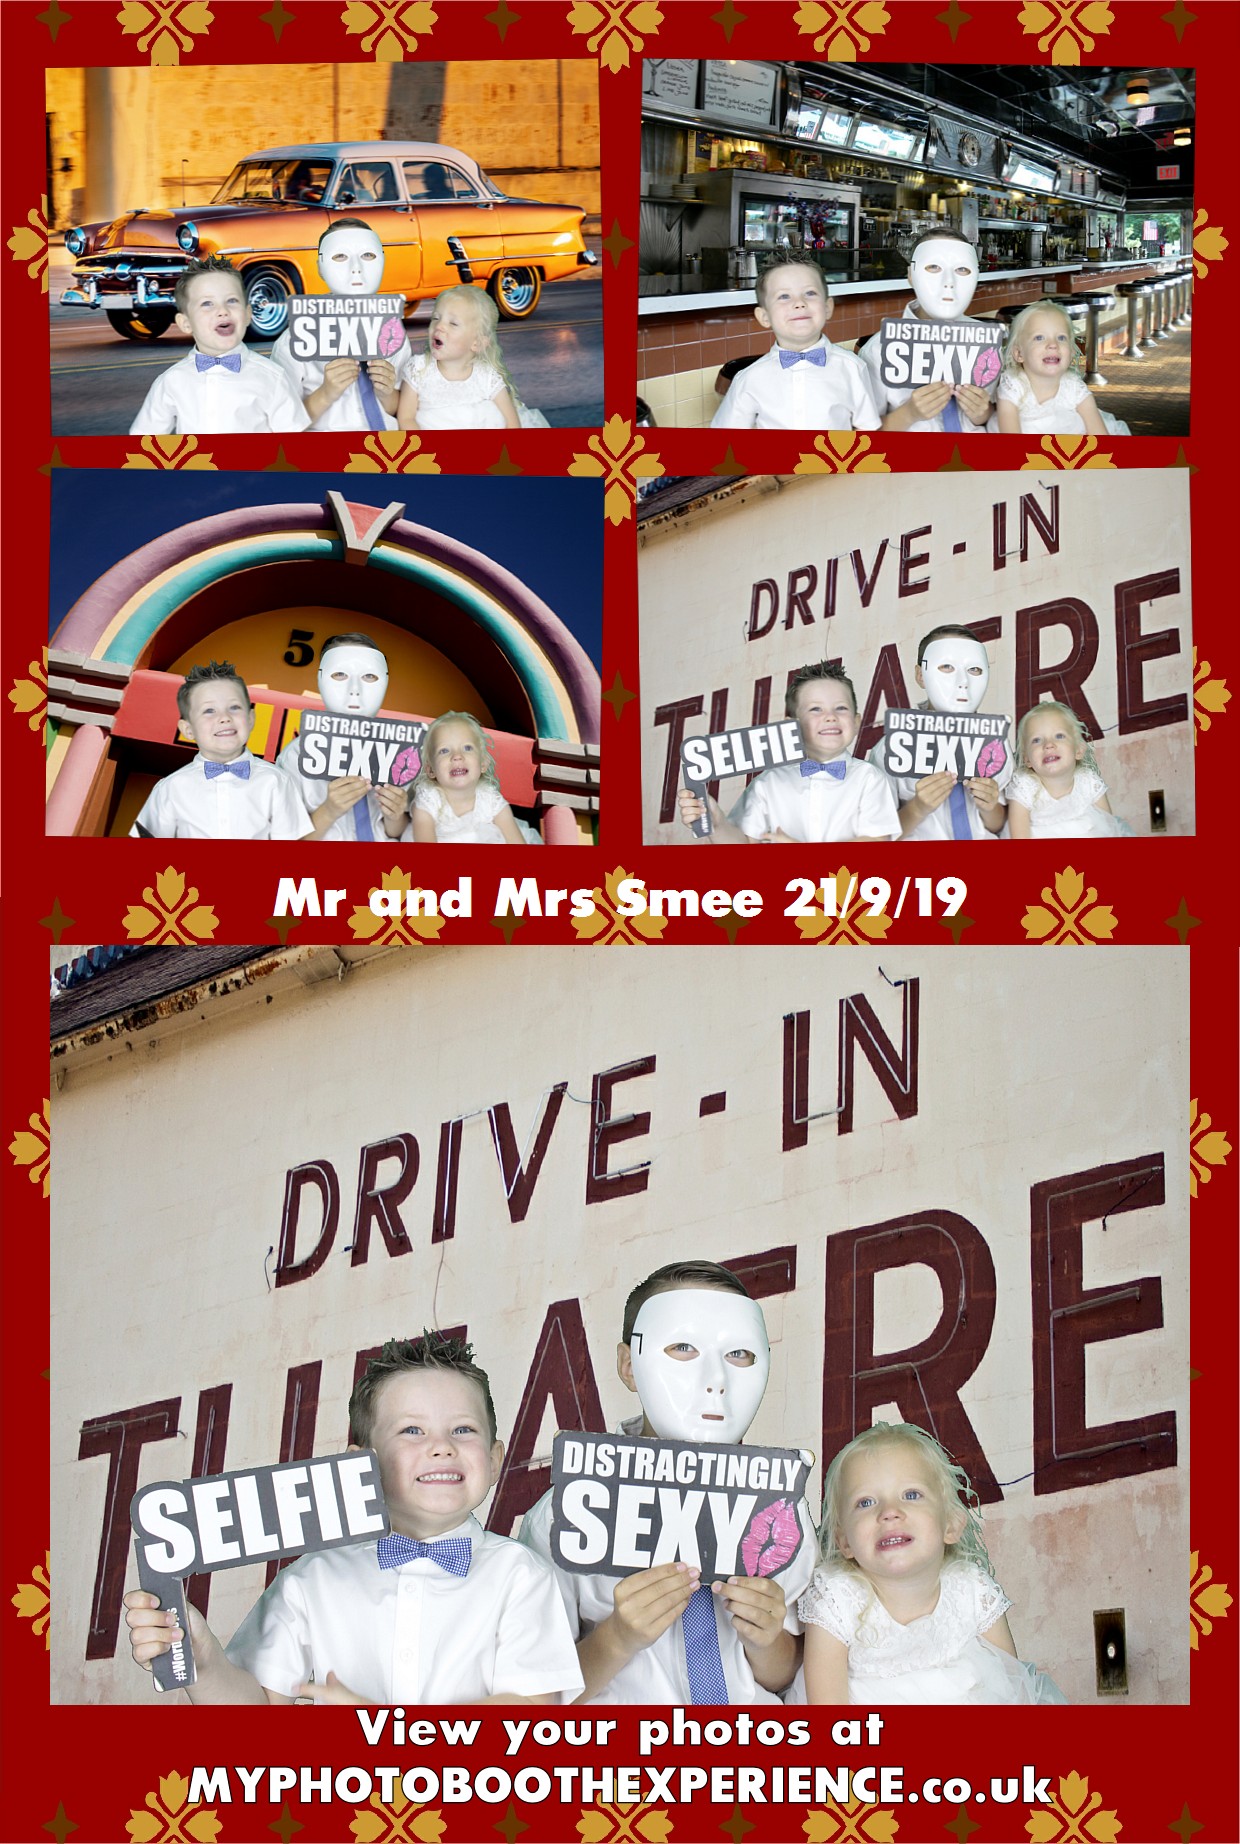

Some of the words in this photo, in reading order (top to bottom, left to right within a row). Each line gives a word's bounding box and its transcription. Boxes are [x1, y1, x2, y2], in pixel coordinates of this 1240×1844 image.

[292, 298, 401, 315] DISTRACTINGLY
[293, 316, 384, 357] SEXY
[885, 322, 1000, 344] DISTRACTINGLY
[884, 341, 981, 385] SEXY
[304, 714, 423, 743] DISTRACTINGLY
[889, 712, 1007, 736] DISTRACTINGLY
[302, 733, 400, 783] SEXY
[683, 721, 804, 781] SELFIE
[888, 731, 985, 777] SEXY
[562, 1440, 802, 1492] DISTRACTINGLY
[138, 1455, 385, 1574] SELFIE
[559, 1479, 758, 1576] SEXY
